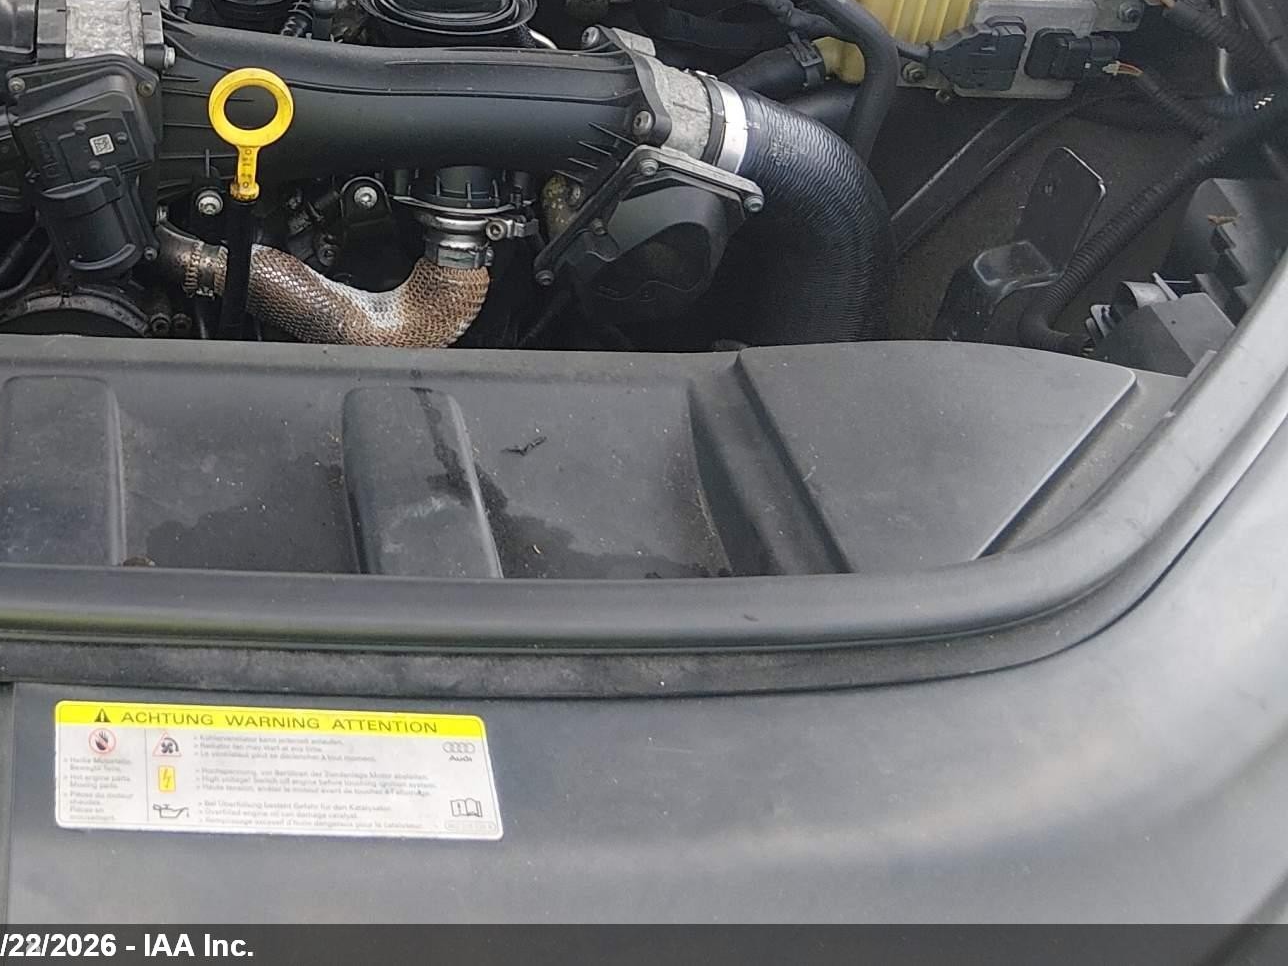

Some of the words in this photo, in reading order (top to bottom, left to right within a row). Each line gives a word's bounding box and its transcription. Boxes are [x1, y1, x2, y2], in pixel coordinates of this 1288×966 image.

[120, 712, 214, 726] ACHTUNG
[225, 715, 320, 730] WARNING
[332, 718, 438, 734] ATTENTION
